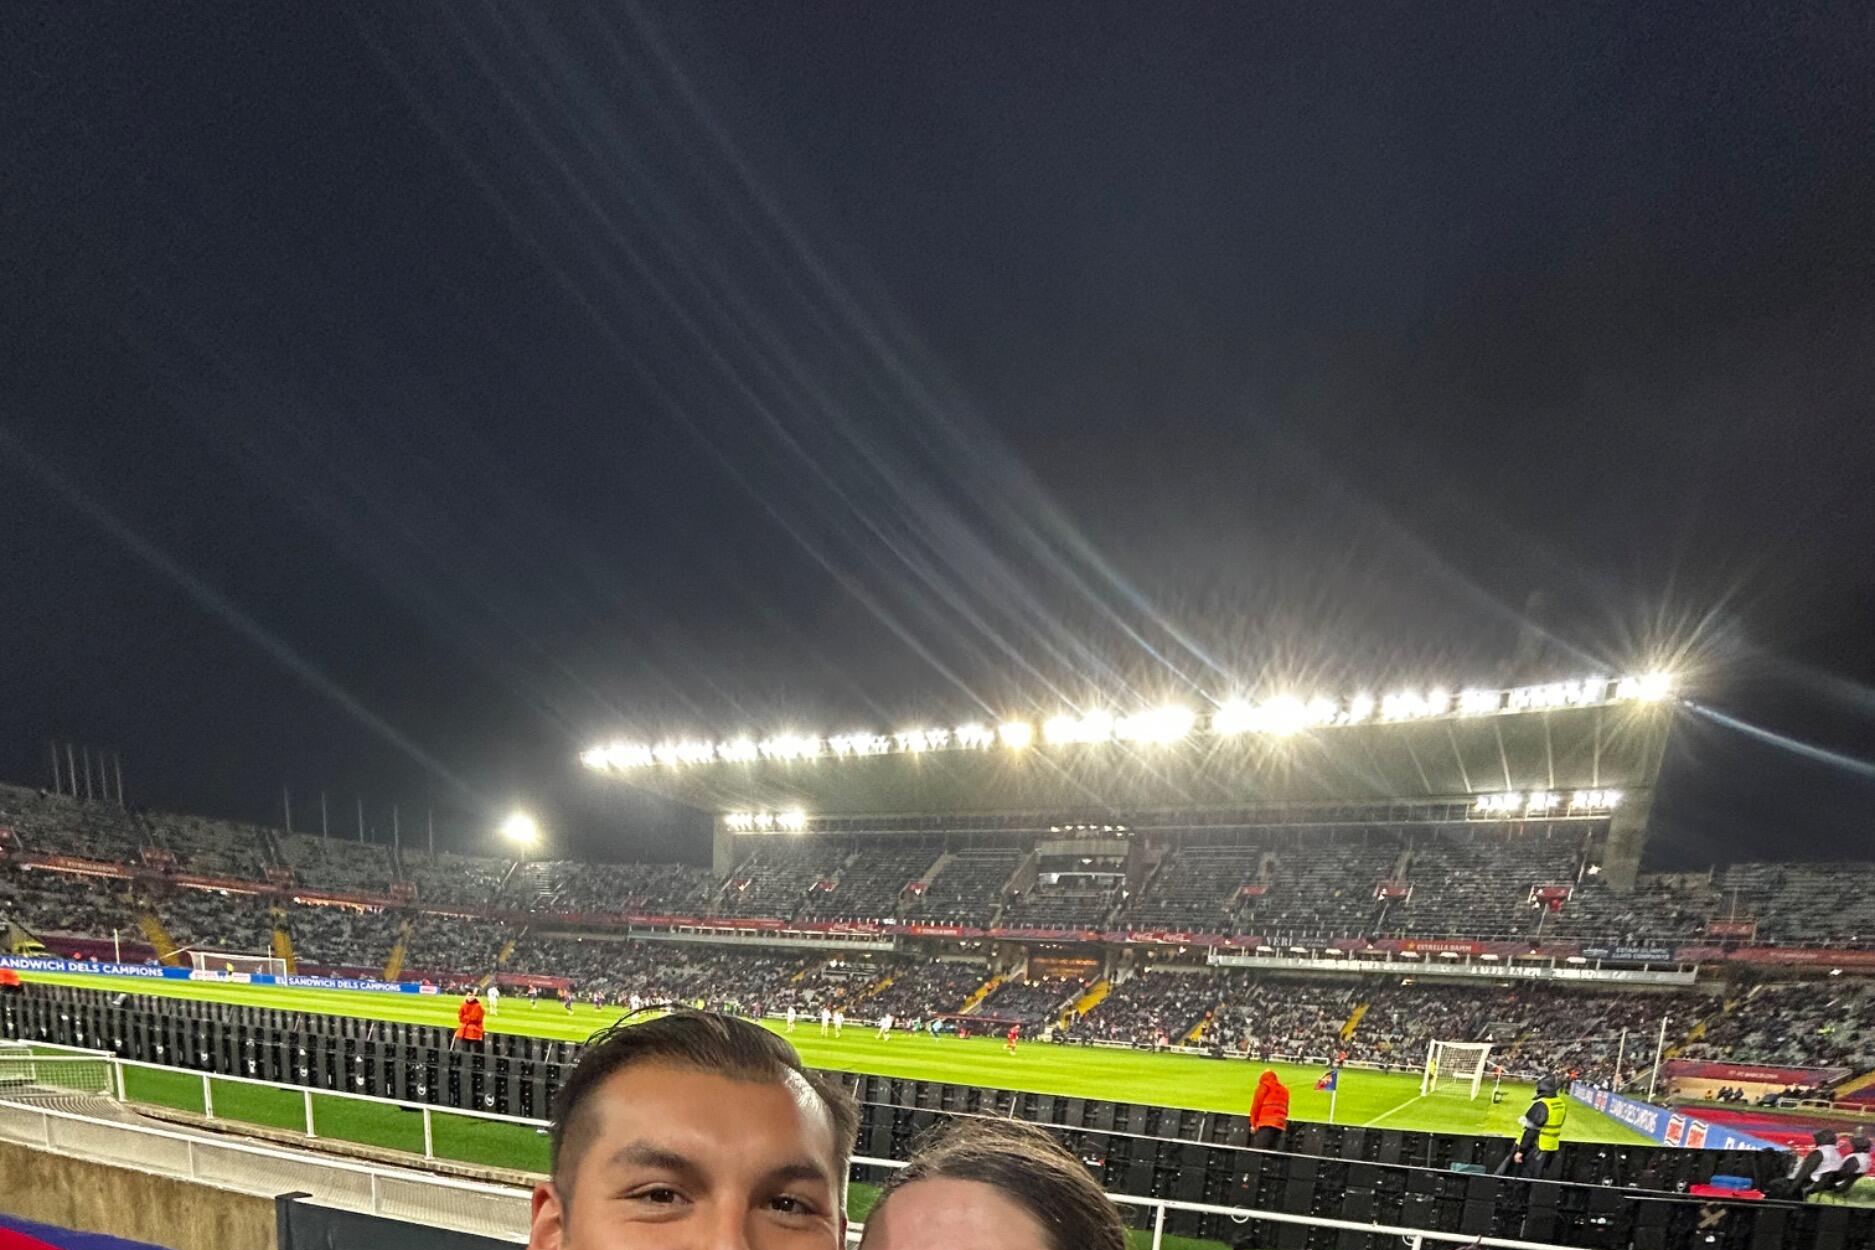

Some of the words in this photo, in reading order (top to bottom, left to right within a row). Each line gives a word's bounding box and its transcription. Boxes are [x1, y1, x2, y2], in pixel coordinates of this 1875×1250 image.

[69, 962, 99, 973] DELS
[103, 964, 163, 976] CAMPIONS
[289, 977, 336, 987] SANDWICH
[338, 979, 359, 989] DELS
[360, 981, 401, 992] CAMPIONS
